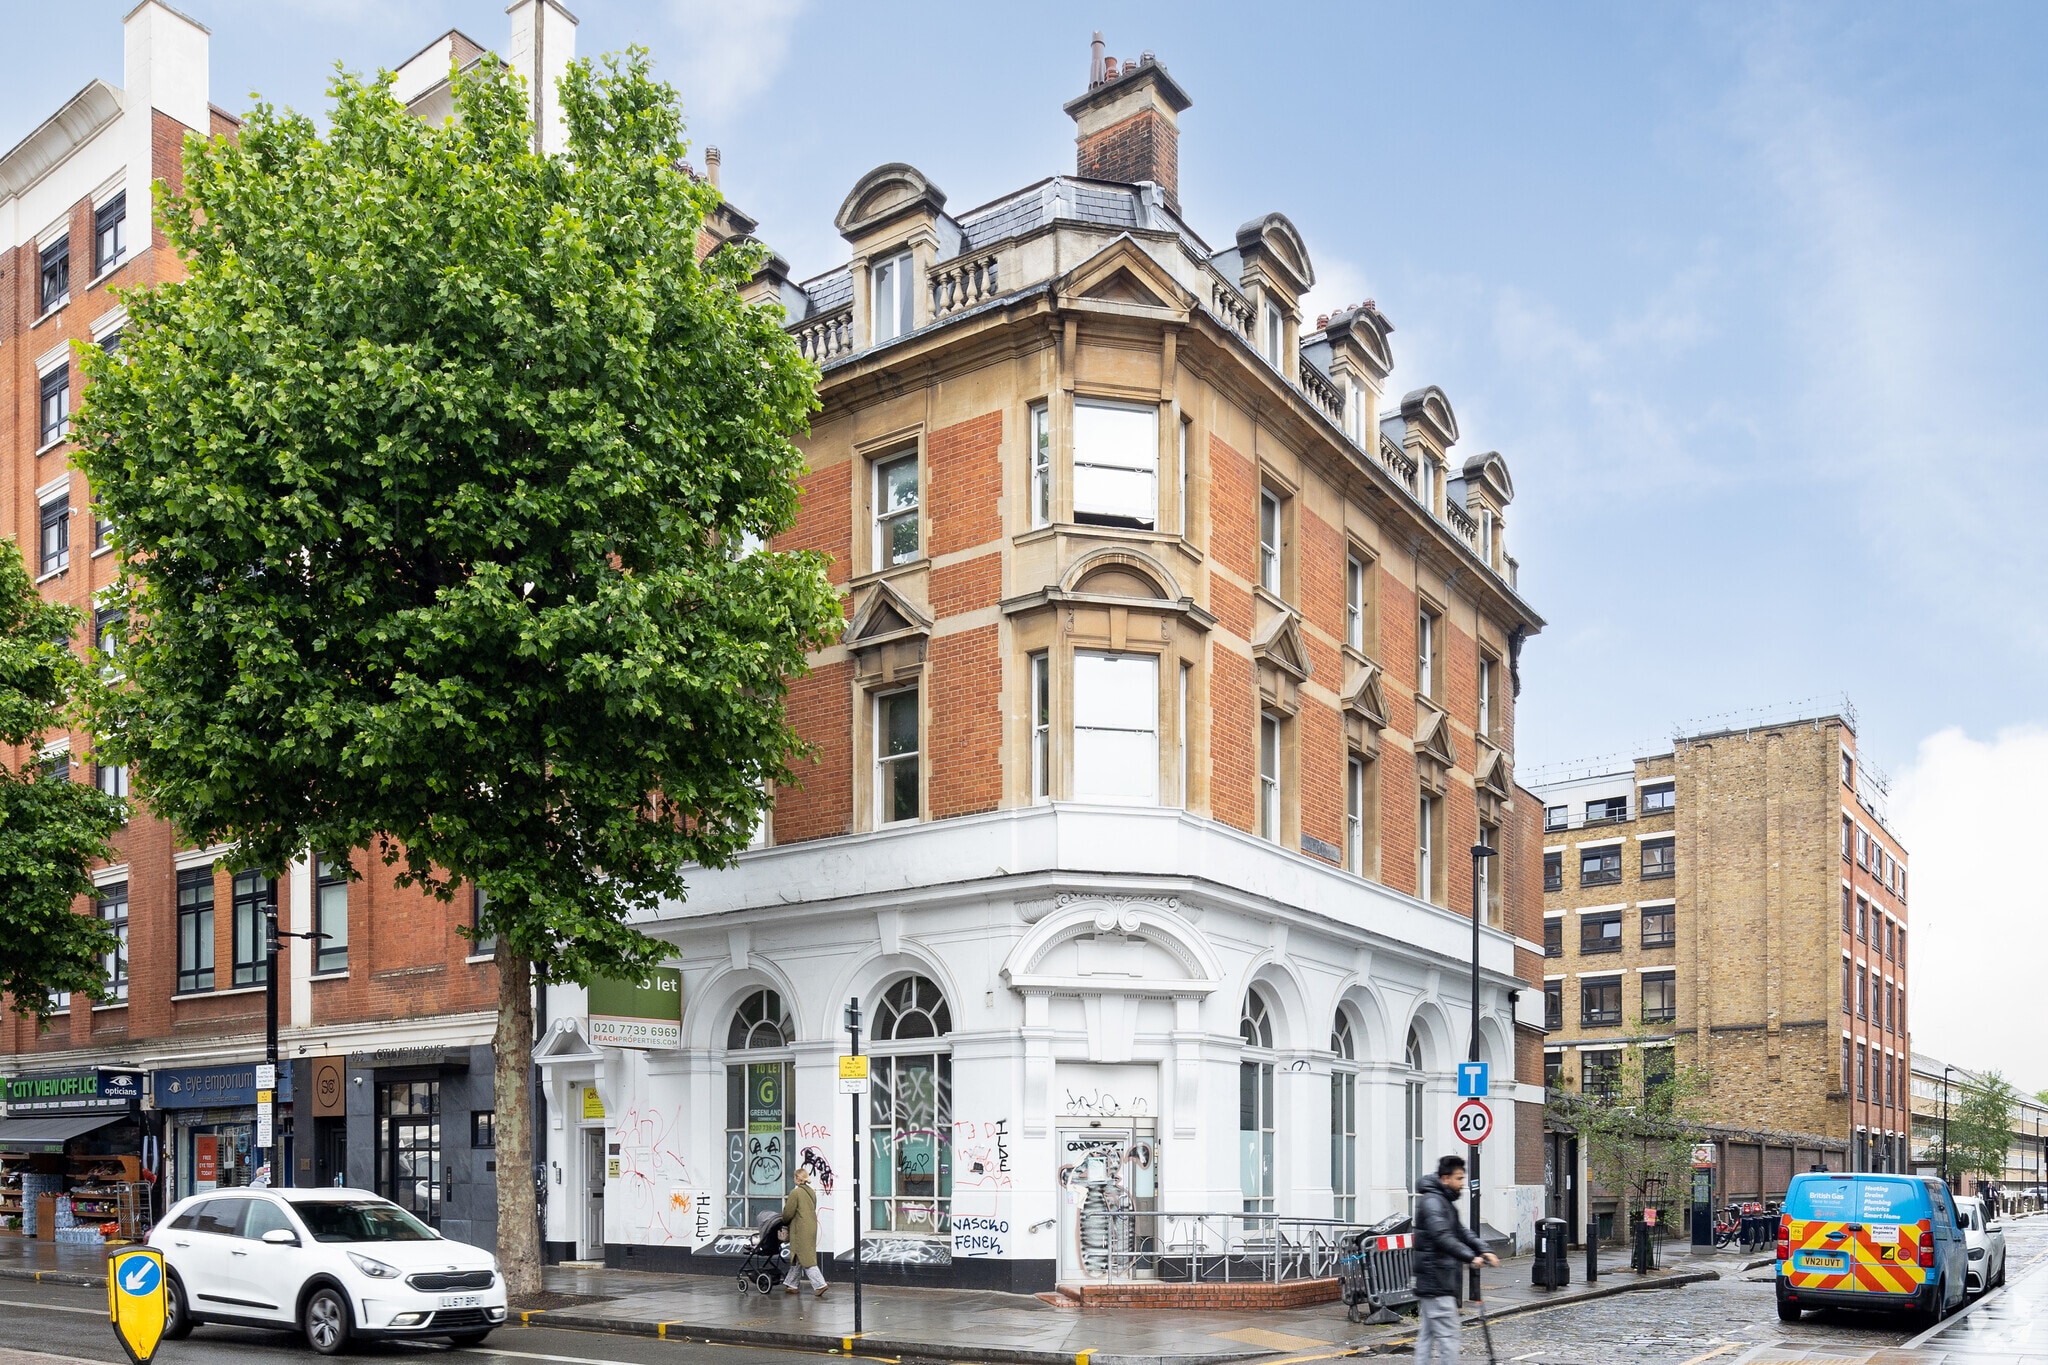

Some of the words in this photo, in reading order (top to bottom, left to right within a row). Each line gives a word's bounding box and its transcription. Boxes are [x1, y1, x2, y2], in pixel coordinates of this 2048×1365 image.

[657, 976, 677, 992] let
[594, 1023, 615, 1034] 020
[620, 1025, 647, 1035] 7739
[651, 1027, 677, 1037] 6969
[415, 1044, 446, 1058] HOUSE
[756, 1063, 765, 1073] TO
[768, 1063, 781, 1073] LET
[13, 1080, 35, 1098] CITY
[35, 1079, 59, 1097] VIEW
[60, 1078, 79, 1095] OFF
[185, 1075, 202, 1097] eye
[205, 1071, 253, 1095] emporium
[105, 1087, 137, 1096] opticians
[761, 1081, 773, 1103] G
[1459, 1113, 1486, 1131] 20
[1864, 1185, 1888, 1193] Heating
[1805, 1256, 1823, 1266] VN21
[1824, 1257, 1841, 1267] UVT
